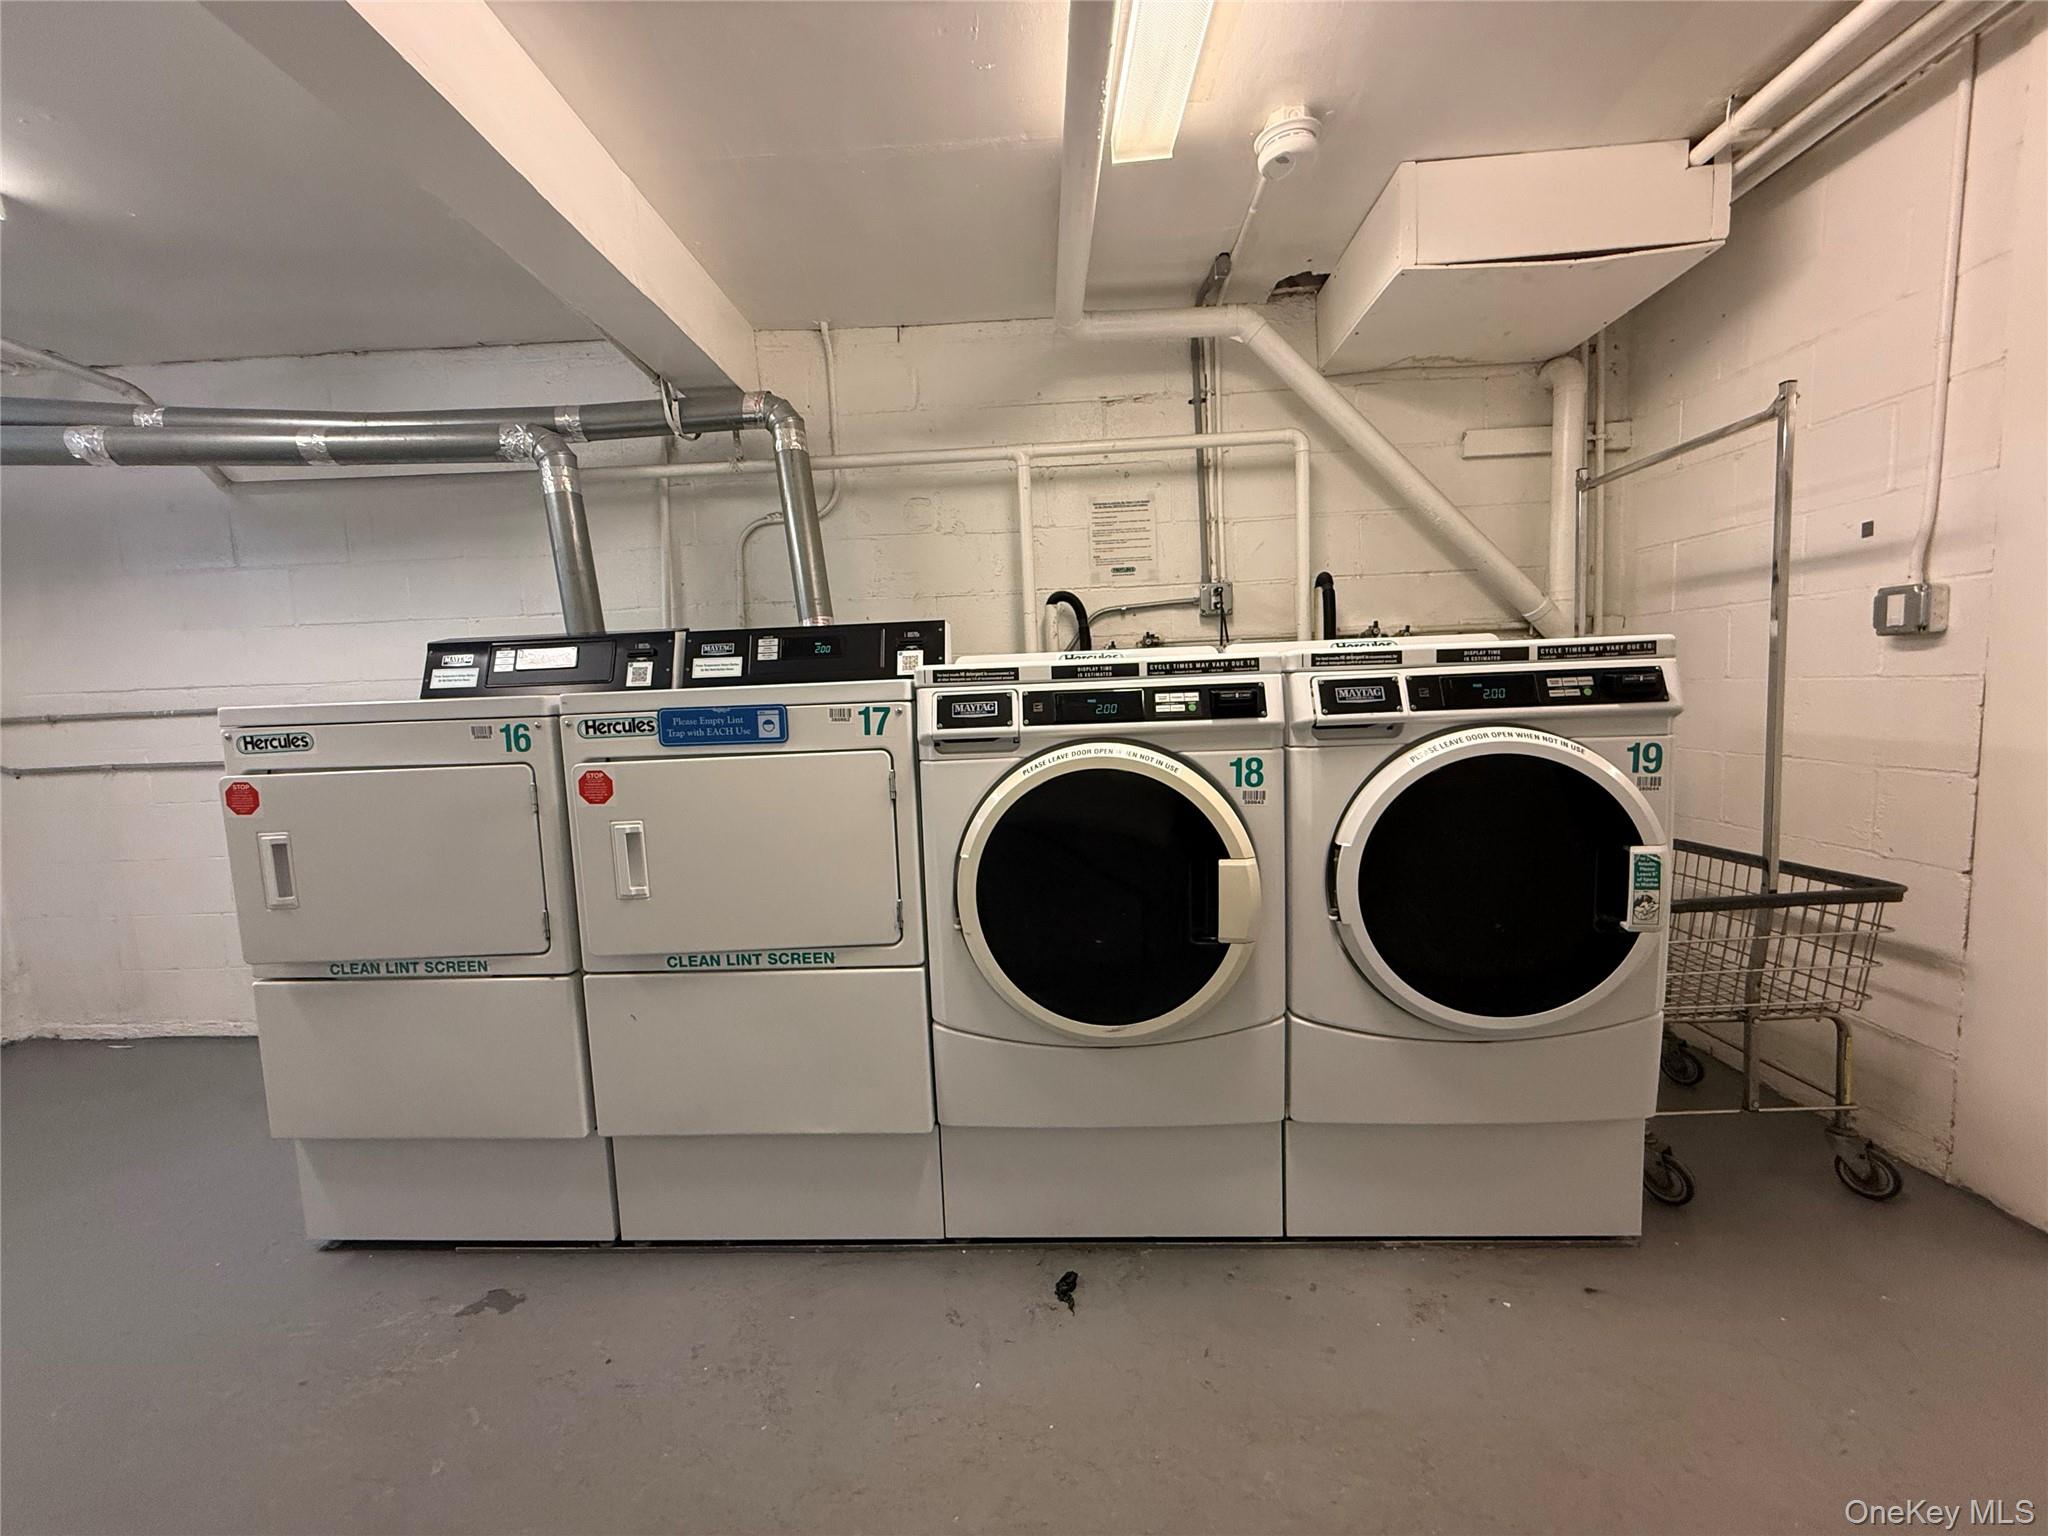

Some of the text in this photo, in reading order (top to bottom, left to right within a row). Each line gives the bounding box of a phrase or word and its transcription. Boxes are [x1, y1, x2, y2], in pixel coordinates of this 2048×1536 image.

[1338, 689, 1381, 698] MAYTAG
[954, 703, 995, 713] MAYTAG
[584, 717, 655, 736] Hercules
[672, 714, 744, 727] Please Empty Lint
[858, 706, 891, 736] 17
[243, 733, 309, 751] Hercules
[499, 723, 532, 753] 16
[667, 727, 752, 739] Trap with EACH Use
[1438, 736, 1464, 749] LEAVE
[1465, 732, 1489, 742] DOOR
[1514, 731, 1540, 740] WHEN
[1542, 735, 1558, 744] NOT
[1560, 740, 1569, 748] IN
[1570, 744, 1585, 755] USE
[1022, 759, 1047, 776] PLEASE
[1047, 752, 1069, 764] LEAVE
[1071, 748, 1092, 757] DOOR
[1139, 753, 1155, 763] NOT
[1164, 762, 1179, 774] USE
[1627, 741, 1663, 774] 19
[1229, 756, 1264, 788] 18
[329, 959, 489, 976] CLEAN LINT SCREEN
[666, 951, 835, 969] CLEAN LINT SCREEN
